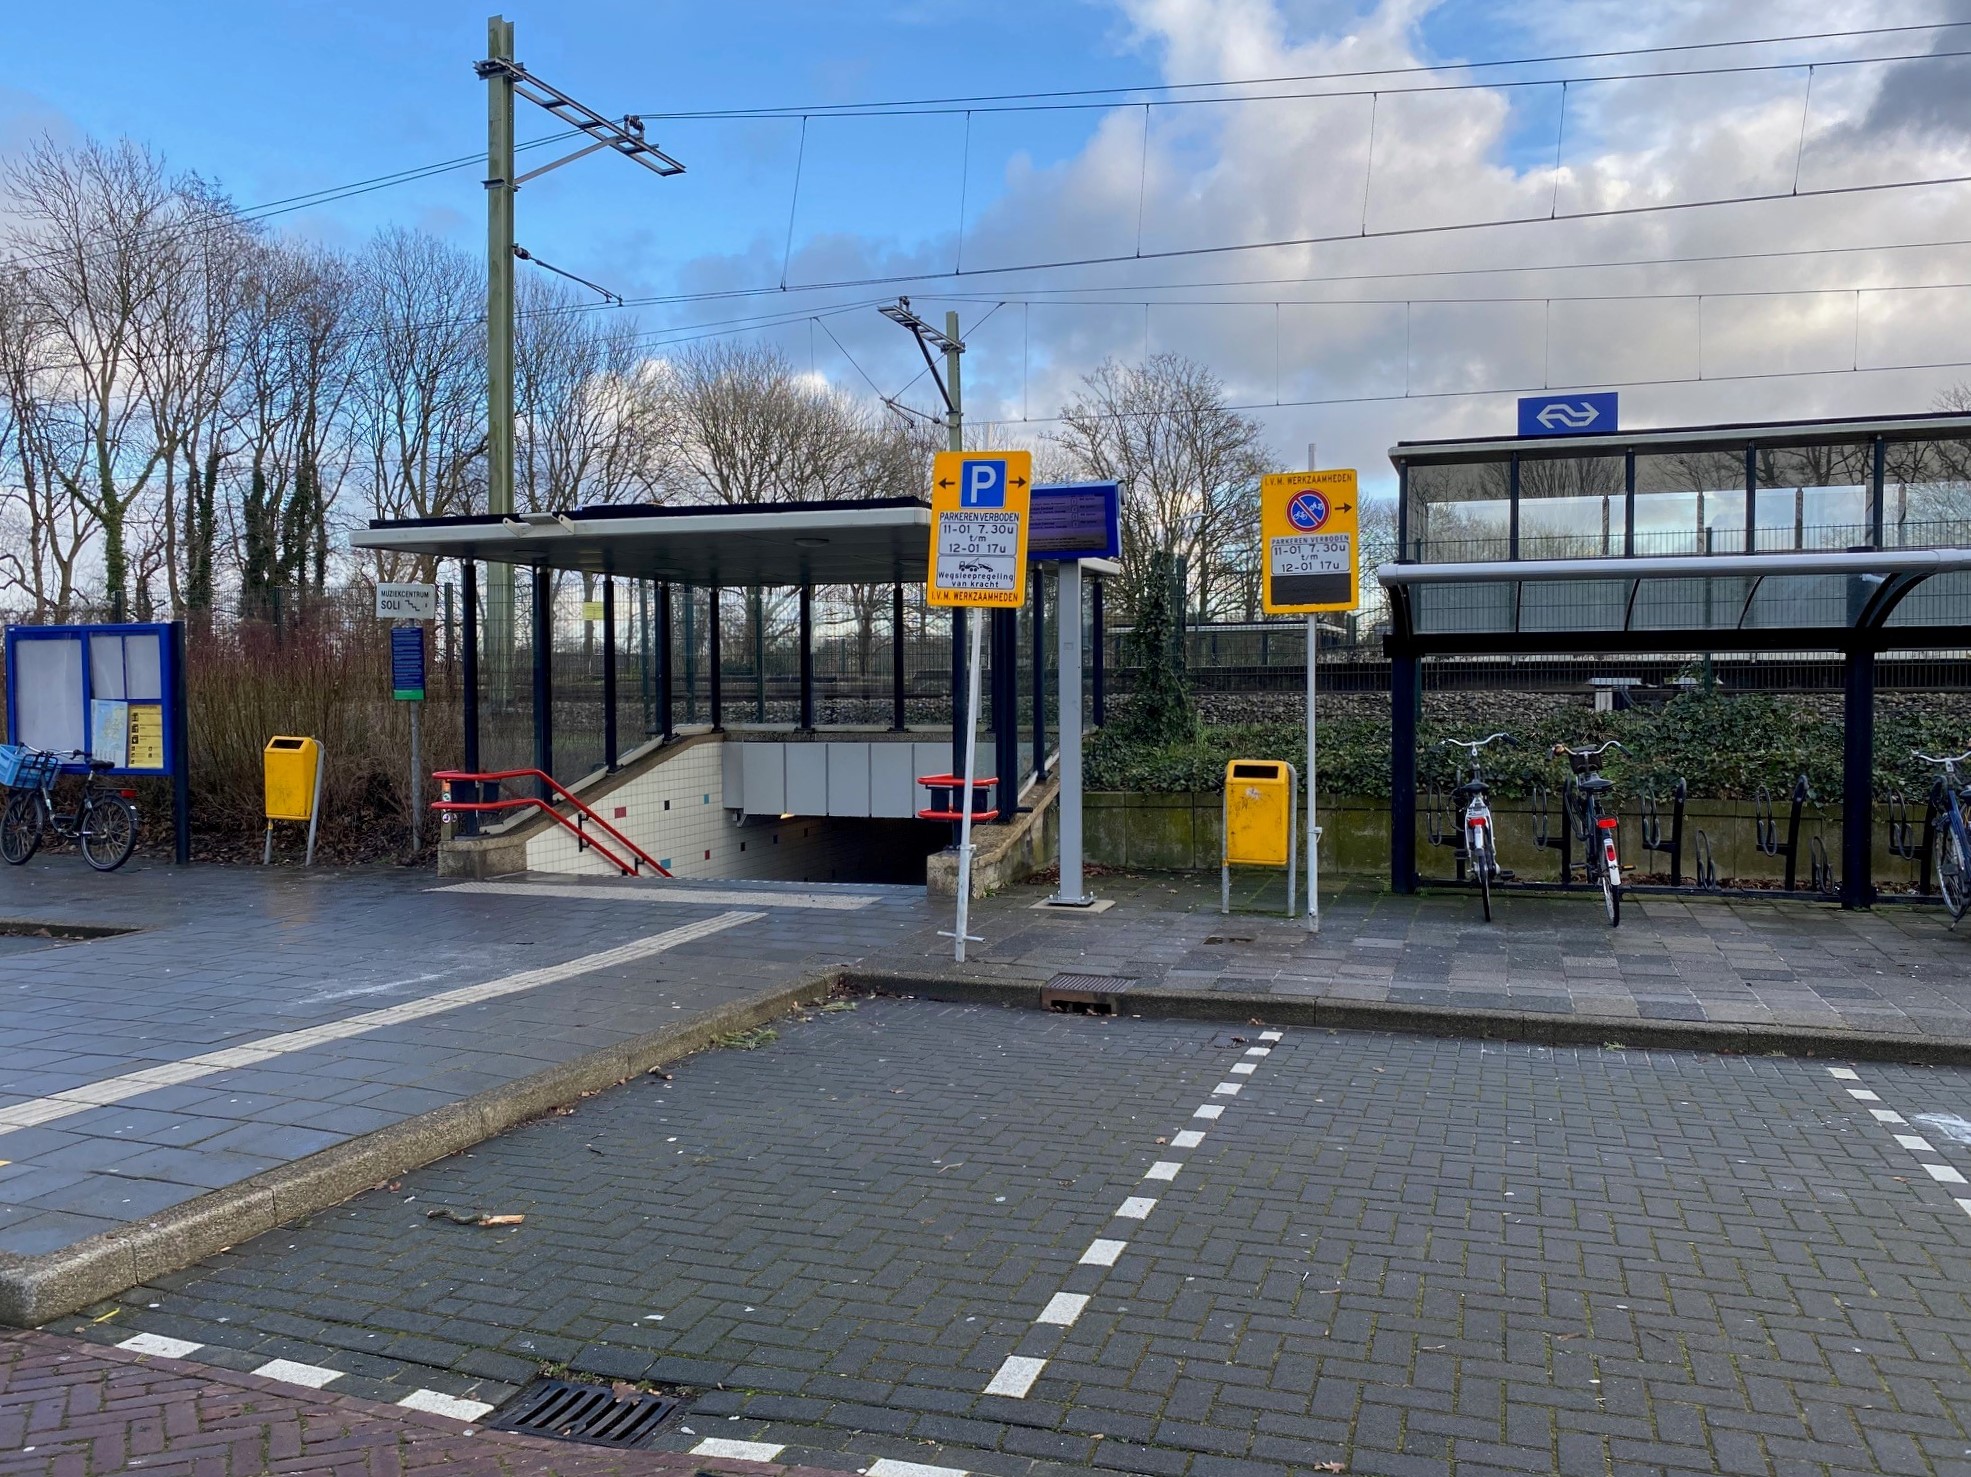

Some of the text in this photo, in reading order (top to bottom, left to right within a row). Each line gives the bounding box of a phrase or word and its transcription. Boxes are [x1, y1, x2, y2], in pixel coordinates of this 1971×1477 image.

[970, 465, 997, 503] P
[1287, 473, 1352, 485] WERKZAAMHEDEN
[939, 513, 979, 522] PARKEREN
[979, 513, 1020, 522] VERBODEN
[943, 525, 971, 534] 11-01
[969, 535, 987, 543] t/m
[1310, 535, 1349, 543] VERBODEN
[949, 544, 1007, 554] 12-01 17u
[1274, 546, 1301, 556] 11-01
[1281, 561, 1340, 573] 12-01 17u
[938, 572, 1014, 582] Wegsleepregeling
[381, 590, 429, 598] MUZIEKCENTRUM
[953, 592, 1019, 602] WERKZAAMHEDEN
[381, 600, 400, 610] SOLI
